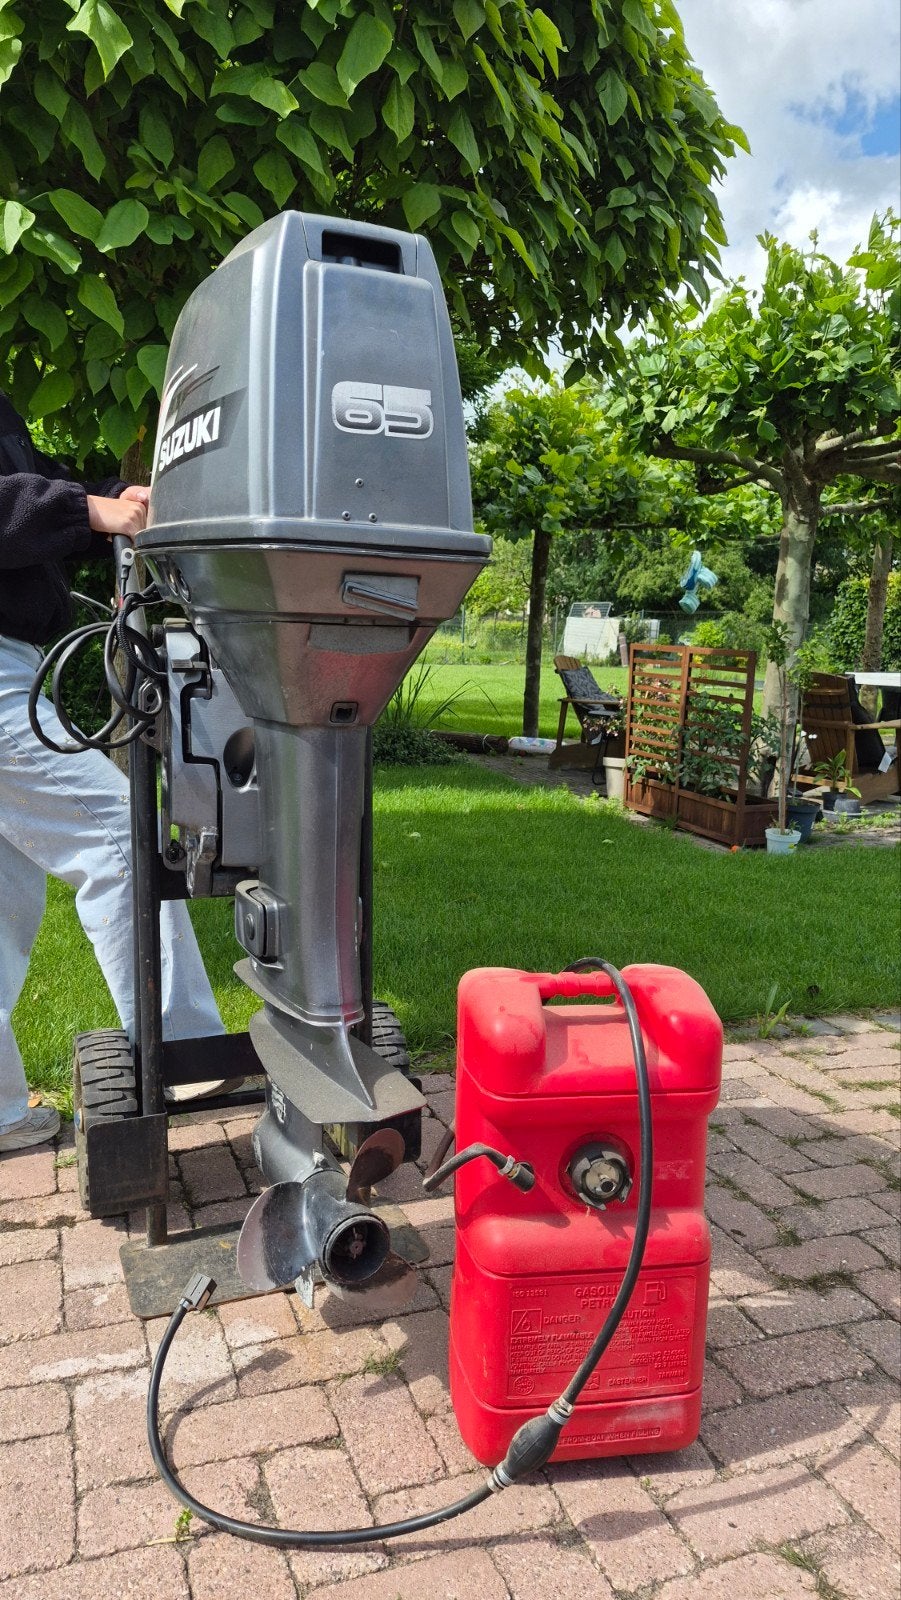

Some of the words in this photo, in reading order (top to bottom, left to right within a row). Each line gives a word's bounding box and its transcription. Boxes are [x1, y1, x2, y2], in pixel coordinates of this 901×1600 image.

[331, 381, 434, 439] 65
[158, 406, 221, 472] SUZUKI
[574, 1285, 620, 1298] GASOLI
[581, 1297, 617, 1309] PETRO
[543, 1314, 581, 1325] DANGER
[623, 1308, 656, 1320] AUTION
